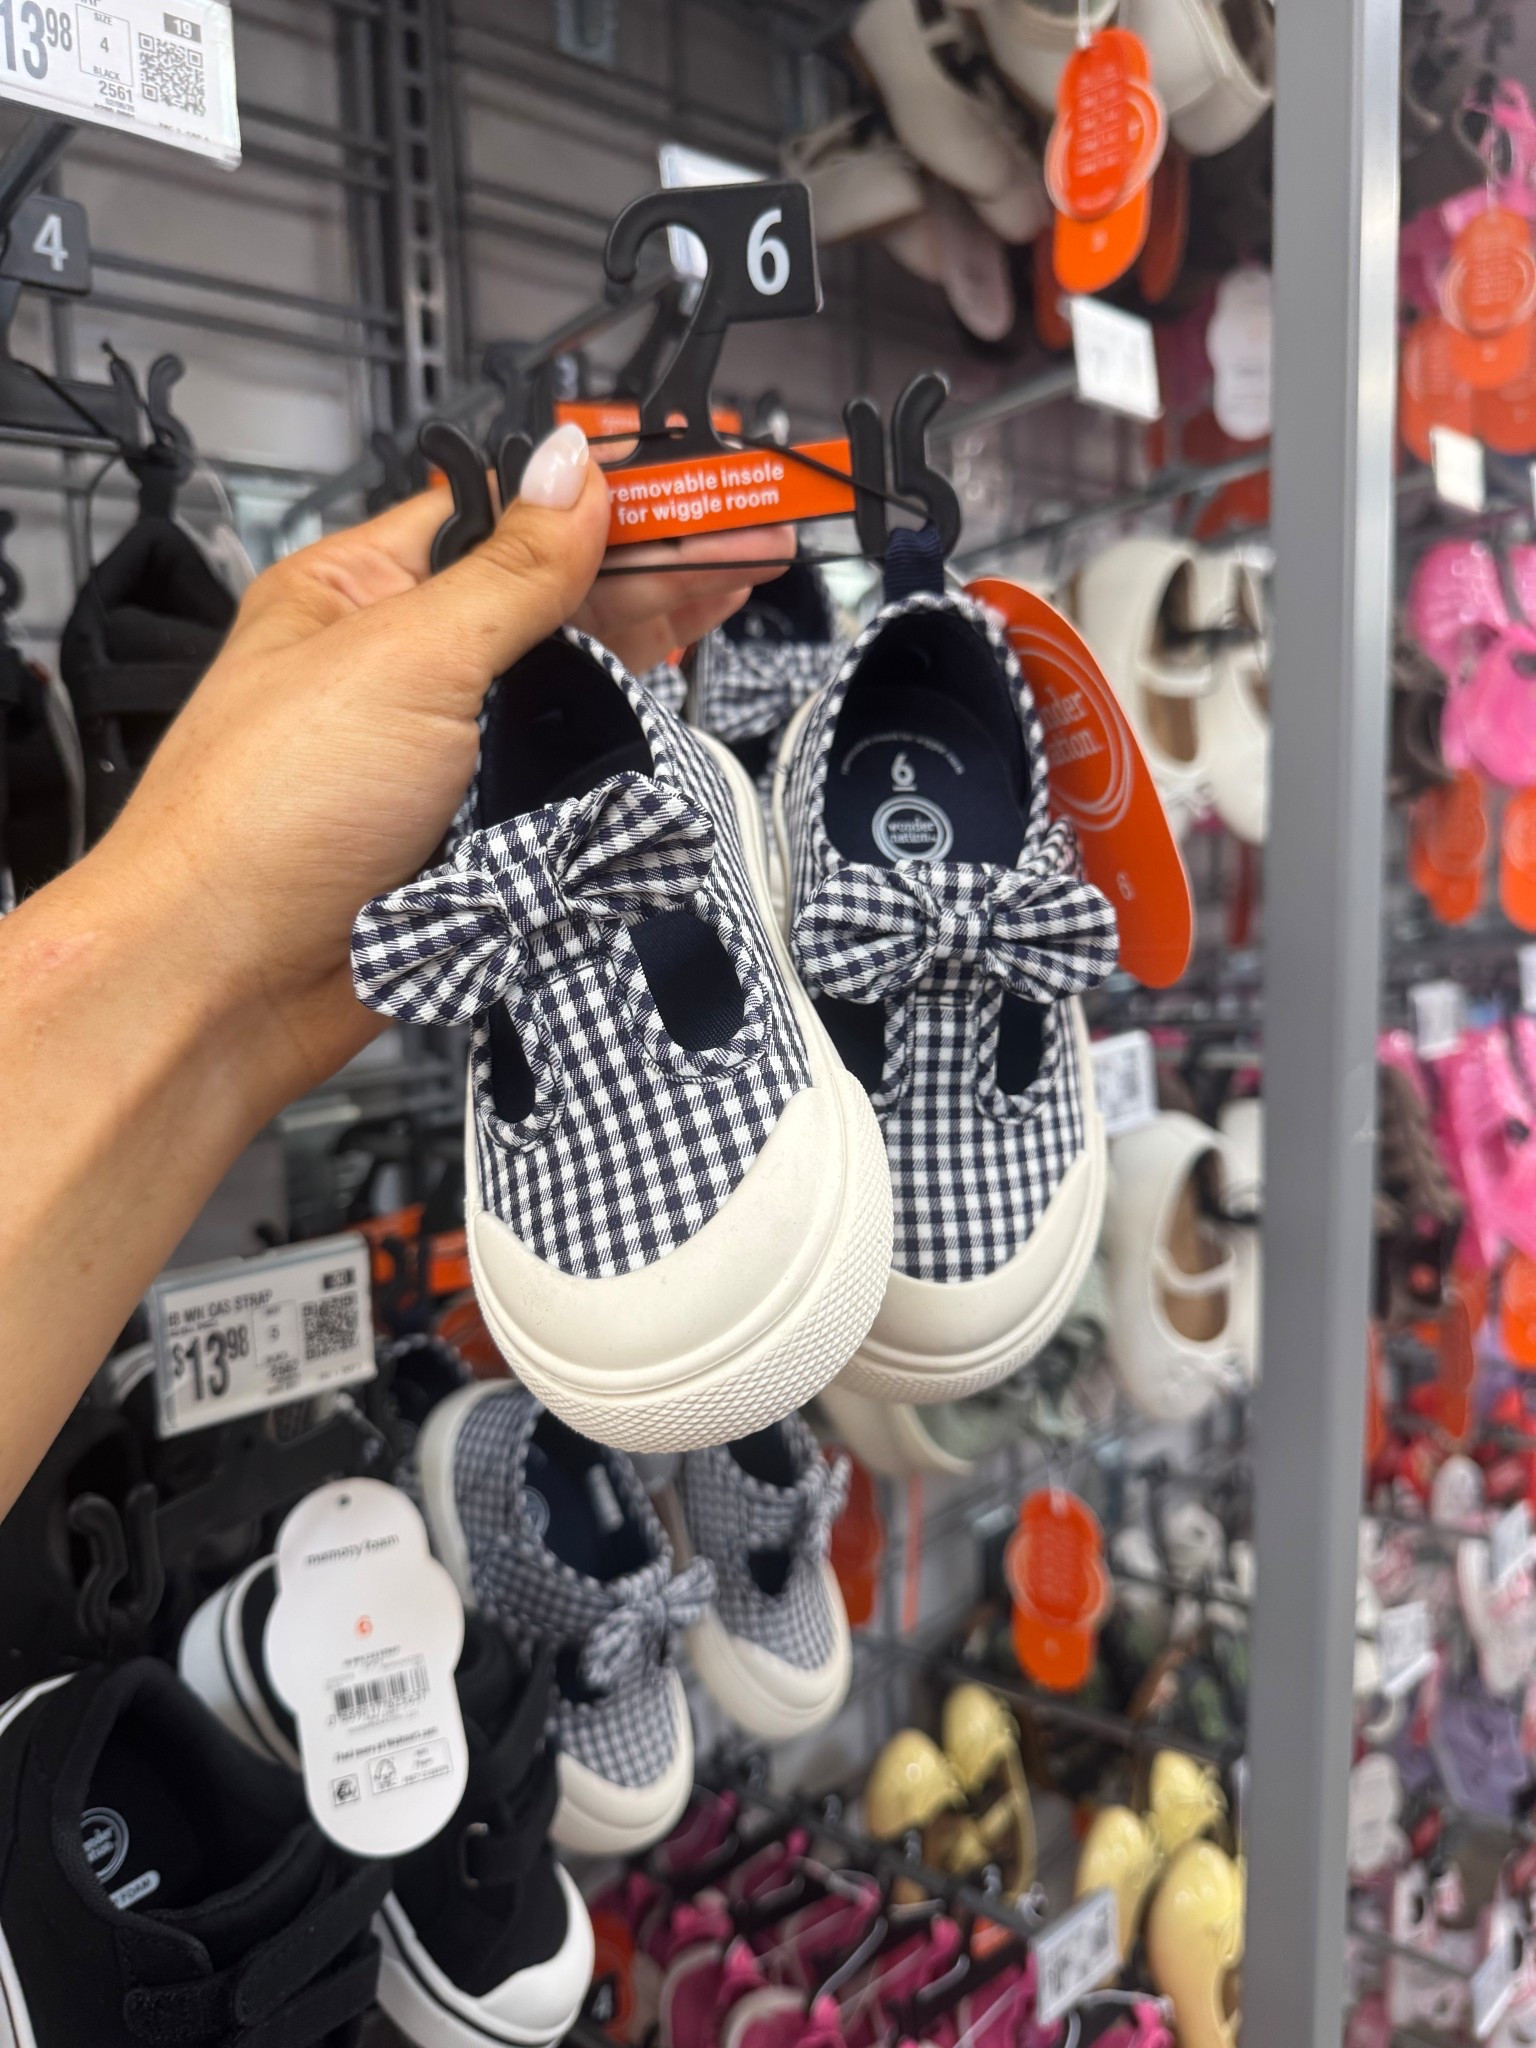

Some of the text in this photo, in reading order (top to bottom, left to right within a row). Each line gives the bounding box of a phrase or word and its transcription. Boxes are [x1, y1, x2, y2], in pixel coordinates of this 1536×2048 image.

[94, 12, 113, 27] SIZE
[173, 18, 193, 39] 19
[100, 37, 109, 53] 4
[94, 65, 120, 81] BLACK
[99, 80, 133, 103] 2561
[33, 213, 69, 272] 4
[746, 208, 791, 296] 6
[609, 459, 784, 502] removable insole
[618, 487, 779, 526] for wiggle room
[1041, 685, 1086, 729] nder
[891, 751, 915, 786] 6
[887, 815, 934, 832] wonder
[1116, 871, 1134, 900] 6
[306, 1534, 400, 1566] memory foam
